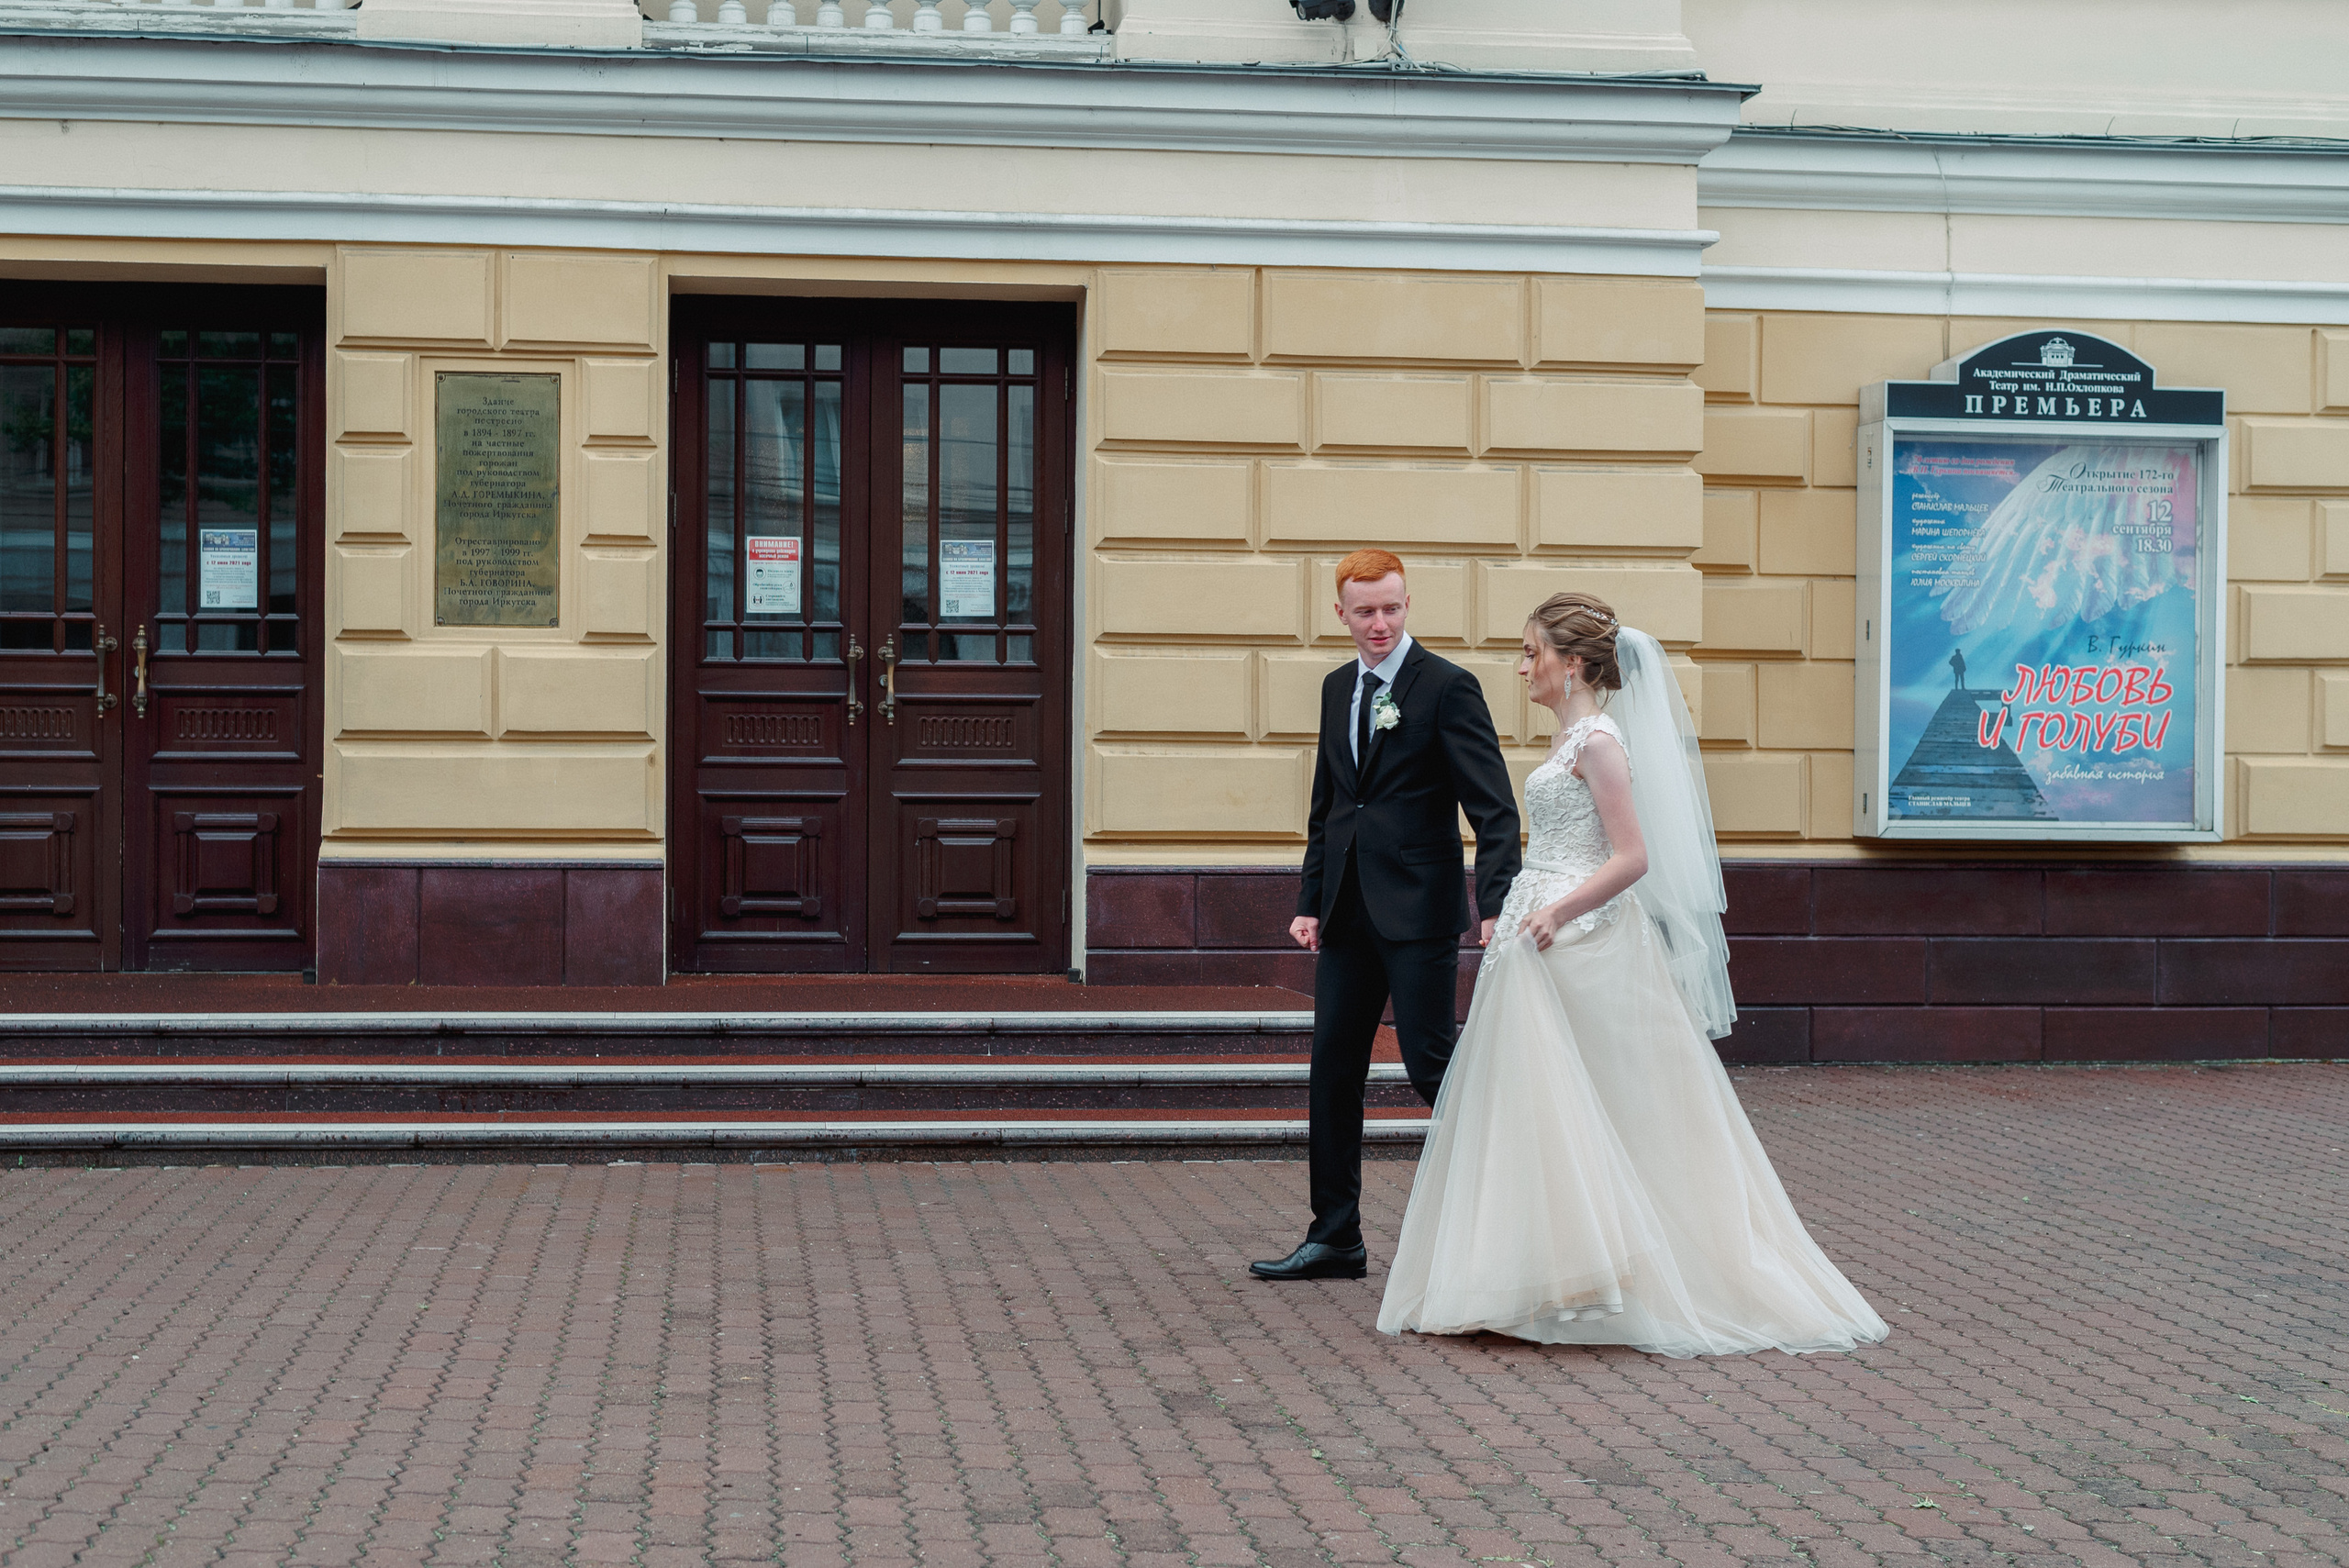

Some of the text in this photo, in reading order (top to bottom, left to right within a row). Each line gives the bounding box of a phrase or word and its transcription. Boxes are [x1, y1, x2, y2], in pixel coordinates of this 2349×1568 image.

[1973, 368, 2141, 382] Академический Драматический
[1989, 381, 2124, 394] Театр им. Н.П.Охлопкова
[483, 397, 514, 406] Здание
[1965, 395, 2147, 417] ПРЕМЬЕРА
[1961, 456, 1975, 464] дня
[1976, 457, 2015, 467] рождения
[1931, 466, 1962, 476] Гуркина
[2069, 462, 2174, 481] Открытие 172-го
[470, 480, 525, 489] губернатора
[2036, 473, 2174, 495] Театрального сезона
[474, 491, 545, 499] ГОРЕМЫКИНА,
[1911, 502, 1989, 514] СТАНИСЛАВ МАЛЬЦЕВ
[2147, 499, 2173, 523] 12
[493, 510, 536, 519] Иркутска
[1911, 527, 1940, 537] МАРИНА
[2111, 524, 2173, 538] сентября
[455, 537, 540, 546] Отреставрировано
[2137, 539, 2173, 553] 18.30
[1911, 552, 1938, 562] СЕРГЕЙ
[470, 568, 525, 577] губернатора
[481, 579, 535, 587] ГОВОРИНА,
[1910, 578, 1980, 587] ЮЛИЯ МОСКВИТИНА
[493, 597, 535, 607] Иркутска
[2087, 635, 2166, 660] В. Гуркин
[2001, 664, 2173, 706] ЛЮБОВЬ
[1978, 707, 2172, 753] И ГОЛУБИ
[2045, 763, 2165, 785] забавная история
